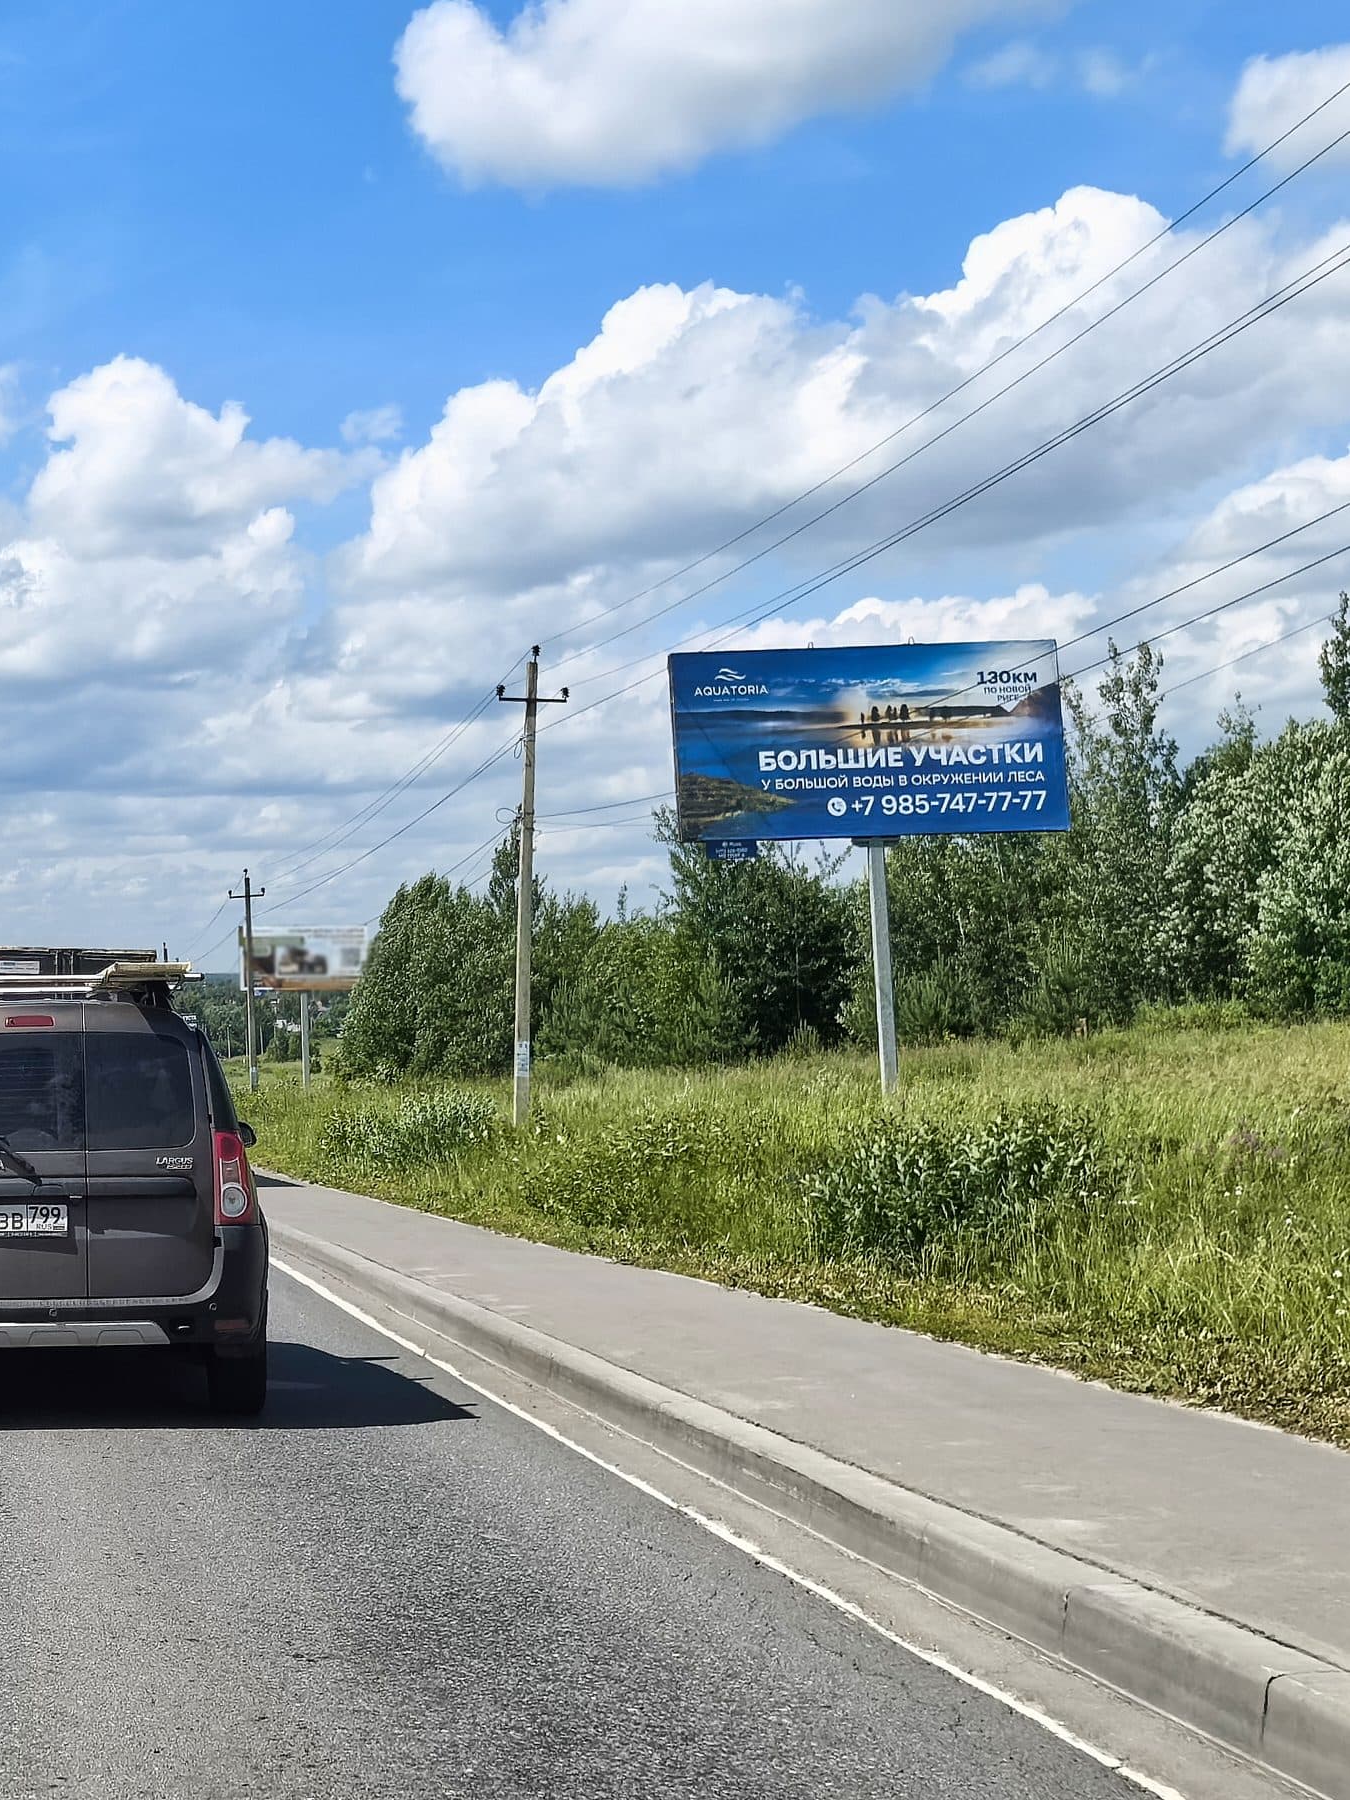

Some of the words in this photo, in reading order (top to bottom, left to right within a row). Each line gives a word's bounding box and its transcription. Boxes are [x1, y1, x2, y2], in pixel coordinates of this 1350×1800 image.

[694, 684, 769, 697] AQUATORIA
[983, 687, 997, 695] ПО
[999, 684, 1031, 694] НОВОЙ
[758, 746, 904, 772] БОЛЬШИЕ
[910, 742, 1044, 767] УЧАСТКИ
[761, 779, 771, 790] У
[775, 774, 848, 790] БОЛЬШОЙ
[853, 775, 894, 788] ВОДЫ
[898, 775, 908, 786] В
[911, 771, 1004, 786] ОКРУЖЕНИИ
[1007, 770, 1045, 783] ЛЕСА
[851, 796, 875, 816] +7
[881, 790, 1047, 816] 985-747-77-77
[155, 1157, 194, 1165] LARGUS
